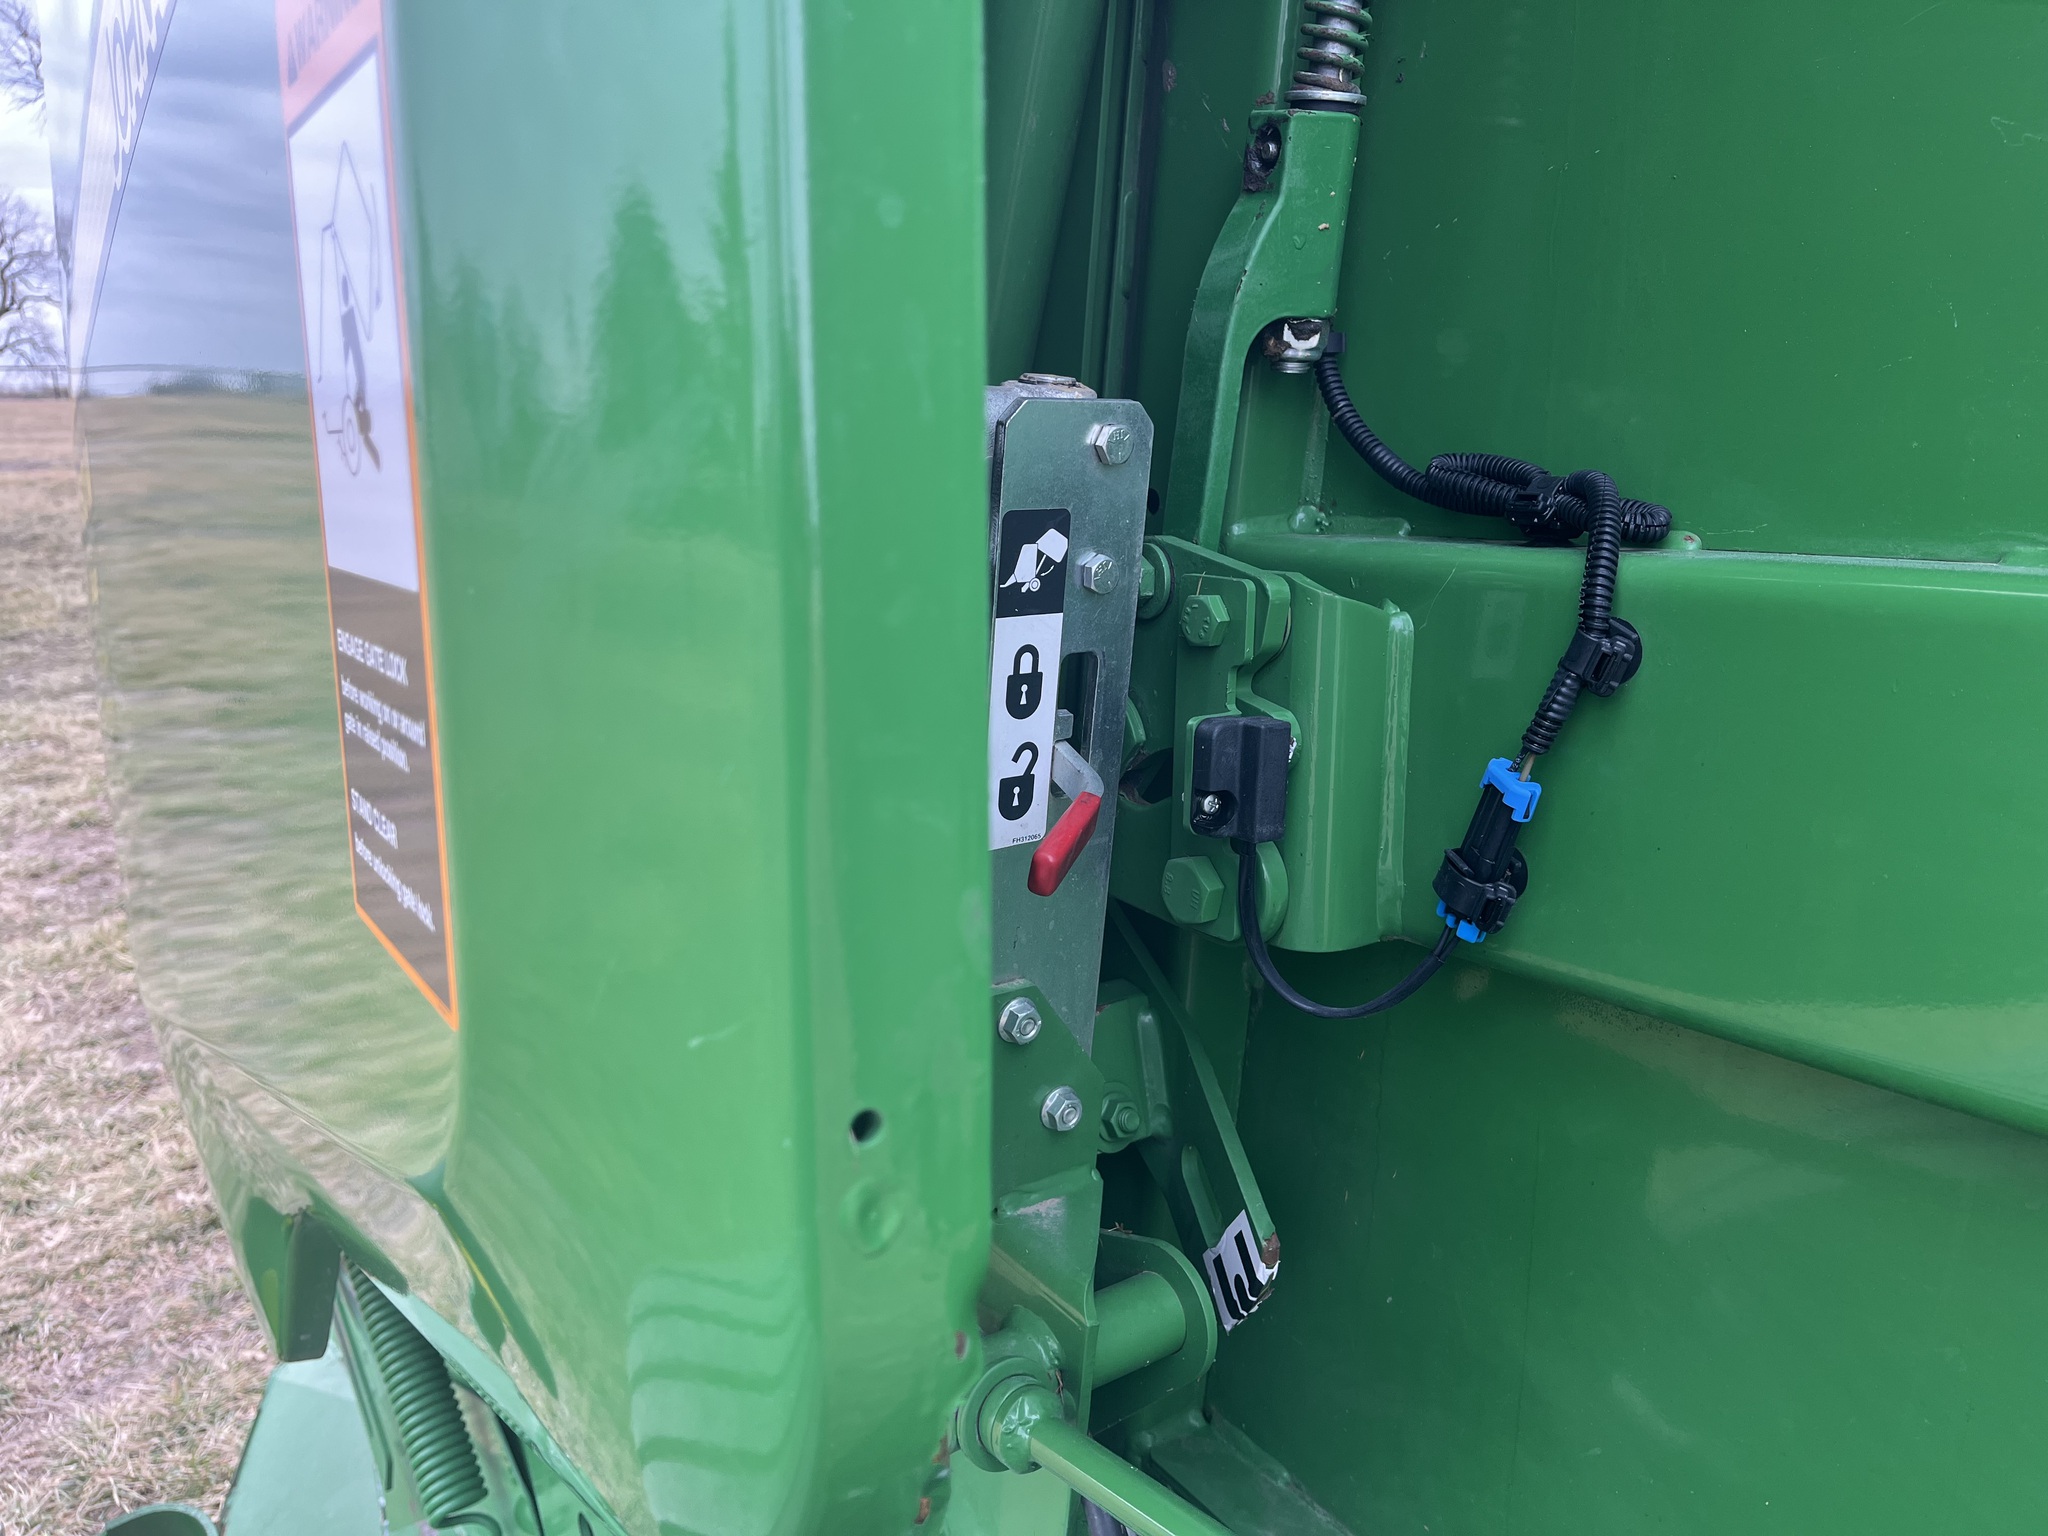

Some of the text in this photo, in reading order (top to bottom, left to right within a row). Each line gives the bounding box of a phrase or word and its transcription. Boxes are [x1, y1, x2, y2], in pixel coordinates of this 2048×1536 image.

[364, 641, 385, 674] GATE
[385, 650, 409, 686] LOCK
[1012, 833, 1042, 844] FH312065
